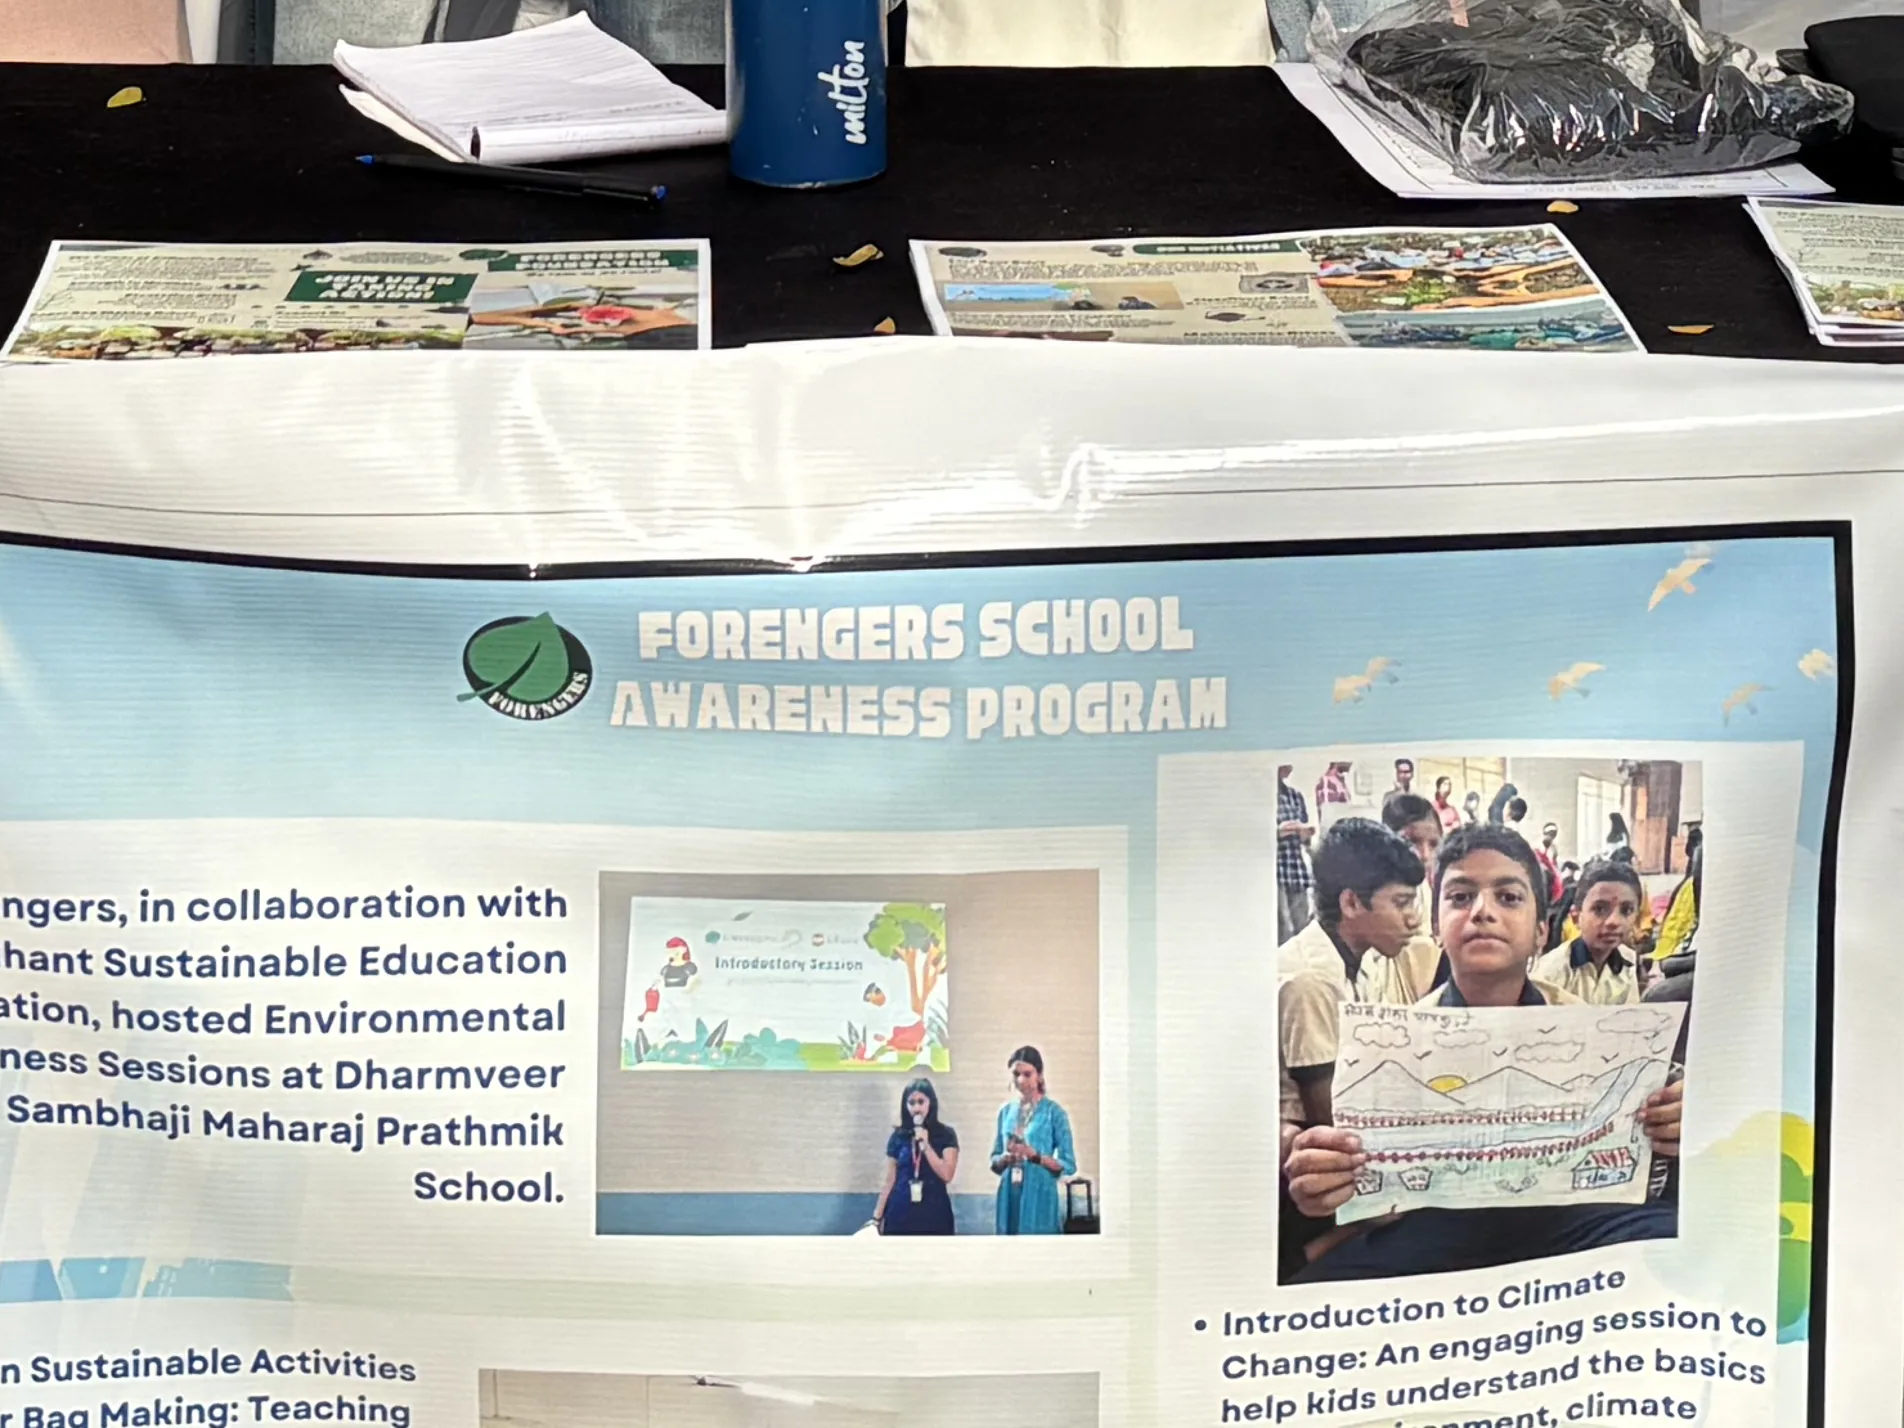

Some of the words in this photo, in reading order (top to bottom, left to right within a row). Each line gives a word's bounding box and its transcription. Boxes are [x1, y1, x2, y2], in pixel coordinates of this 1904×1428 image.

[817, 40, 869, 145] milton
[637, 603, 965, 661] FORENGERS
[978, 595, 1195, 657] SCHOOL
[488, 671, 588, 719] FORENGERS
[609, 680, 952, 738] AWARENESS
[966, 676, 1228, 740] PROGRAM
[140, 888, 175, 923] in
[187, 885, 466, 922] collaboration
[477, 885, 568, 919] with
[104, 944, 347, 978] Sustainable
[359, 942, 567, 976] Education
[715, 956, 805, 972] Introductory
[810, 958, 863, 971] Session
[112, 999, 251, 1035] hosted
[264, 999, 566, 1036] Environmental
[97, 1050, 270, 1089] Sessions
[282, 1060, 324, 1090] at
[334, 1059, 566, 1090] Dharmveer
[6, 1095, 191, 1140] Sambhaji
[202, 1111, 365, 1152] Maharaj
[376, 1112, 565, 1146] Prathmik
[413, 1171, 564, 1204] School.
[1223, 1297, 1445, 1336] Introduction
[1453, 1293, 1489, 1316] to
[1497, 1267, 1625, 1310] Climate
[1222, 1348, 1368, 1381] Change:
[1375, 1342, 1421, 1367] An
[1428, 1318, 1585, 1362] engaging
[1592, 1303, 1720, 1334] session
[1730, 1311, 1767, 1337] to
[30, 1347, 242, 1382] Sustainable
[250, 1348, 417, 1382] Activities
[1222, 1397, 1296, 1424] help
[1307, 1381, 1377, 1415] kids
[1386, 1357, 1579, 1408] understand
[1587, 1349, 1646, 1376] the
[1654, 1349, 1766, 1385] basics
[23, 1406, 89, 1428] Bag
[99, 1396, 239, 1428] Making:
[246, 1394, 411, 1428] Teaching
[1566, 1392, 1697, 1423] climate
